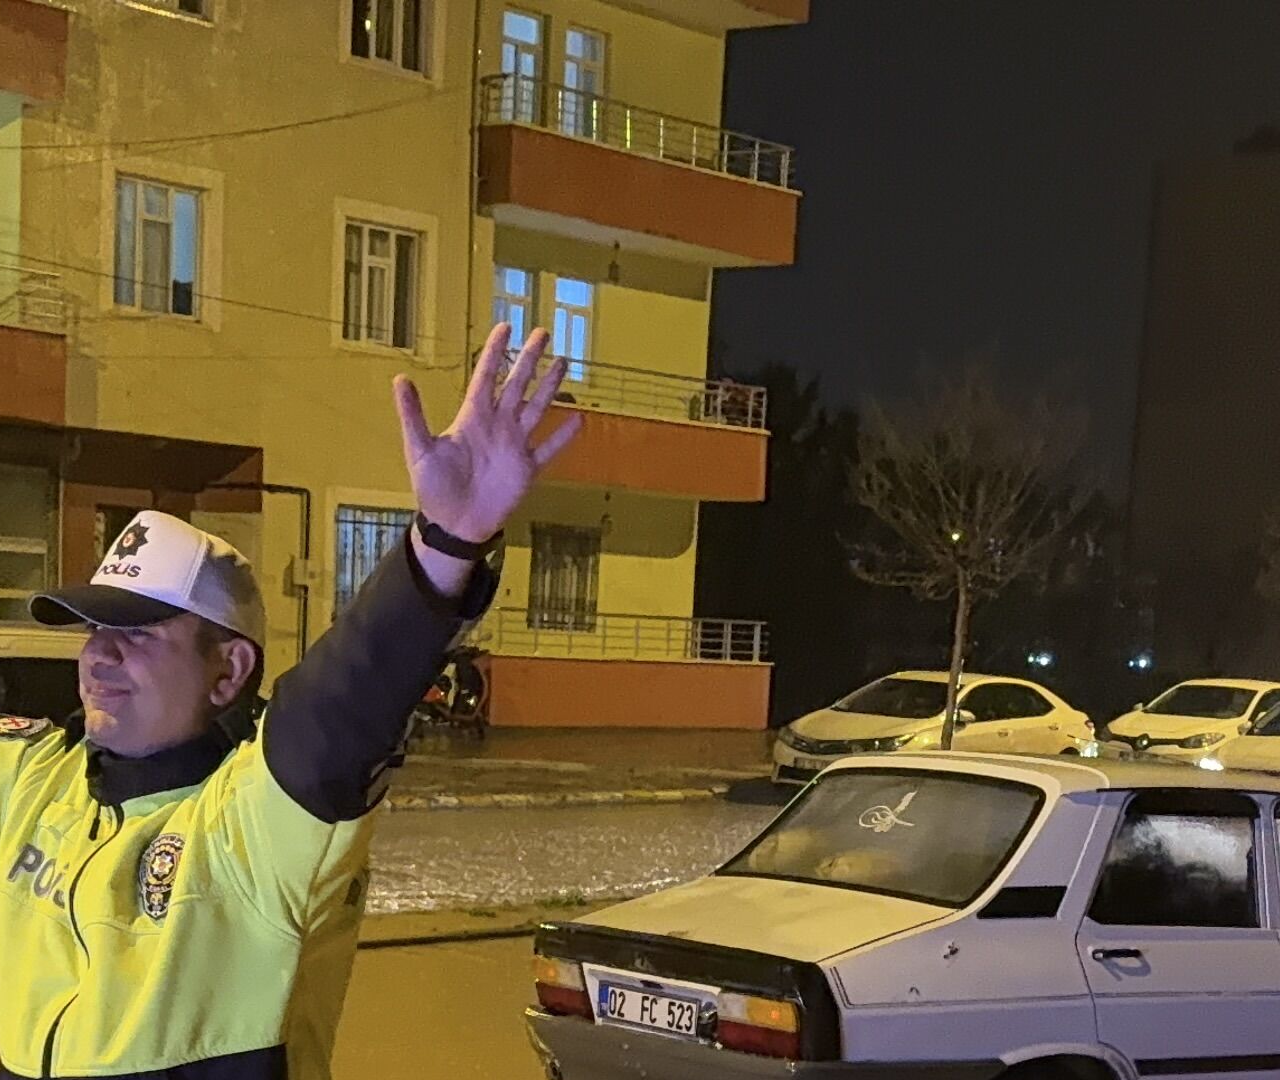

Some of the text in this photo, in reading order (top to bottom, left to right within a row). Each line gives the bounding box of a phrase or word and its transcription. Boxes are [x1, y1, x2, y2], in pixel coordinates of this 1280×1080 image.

[609, 989, 694, 1032] 02 FC 523
